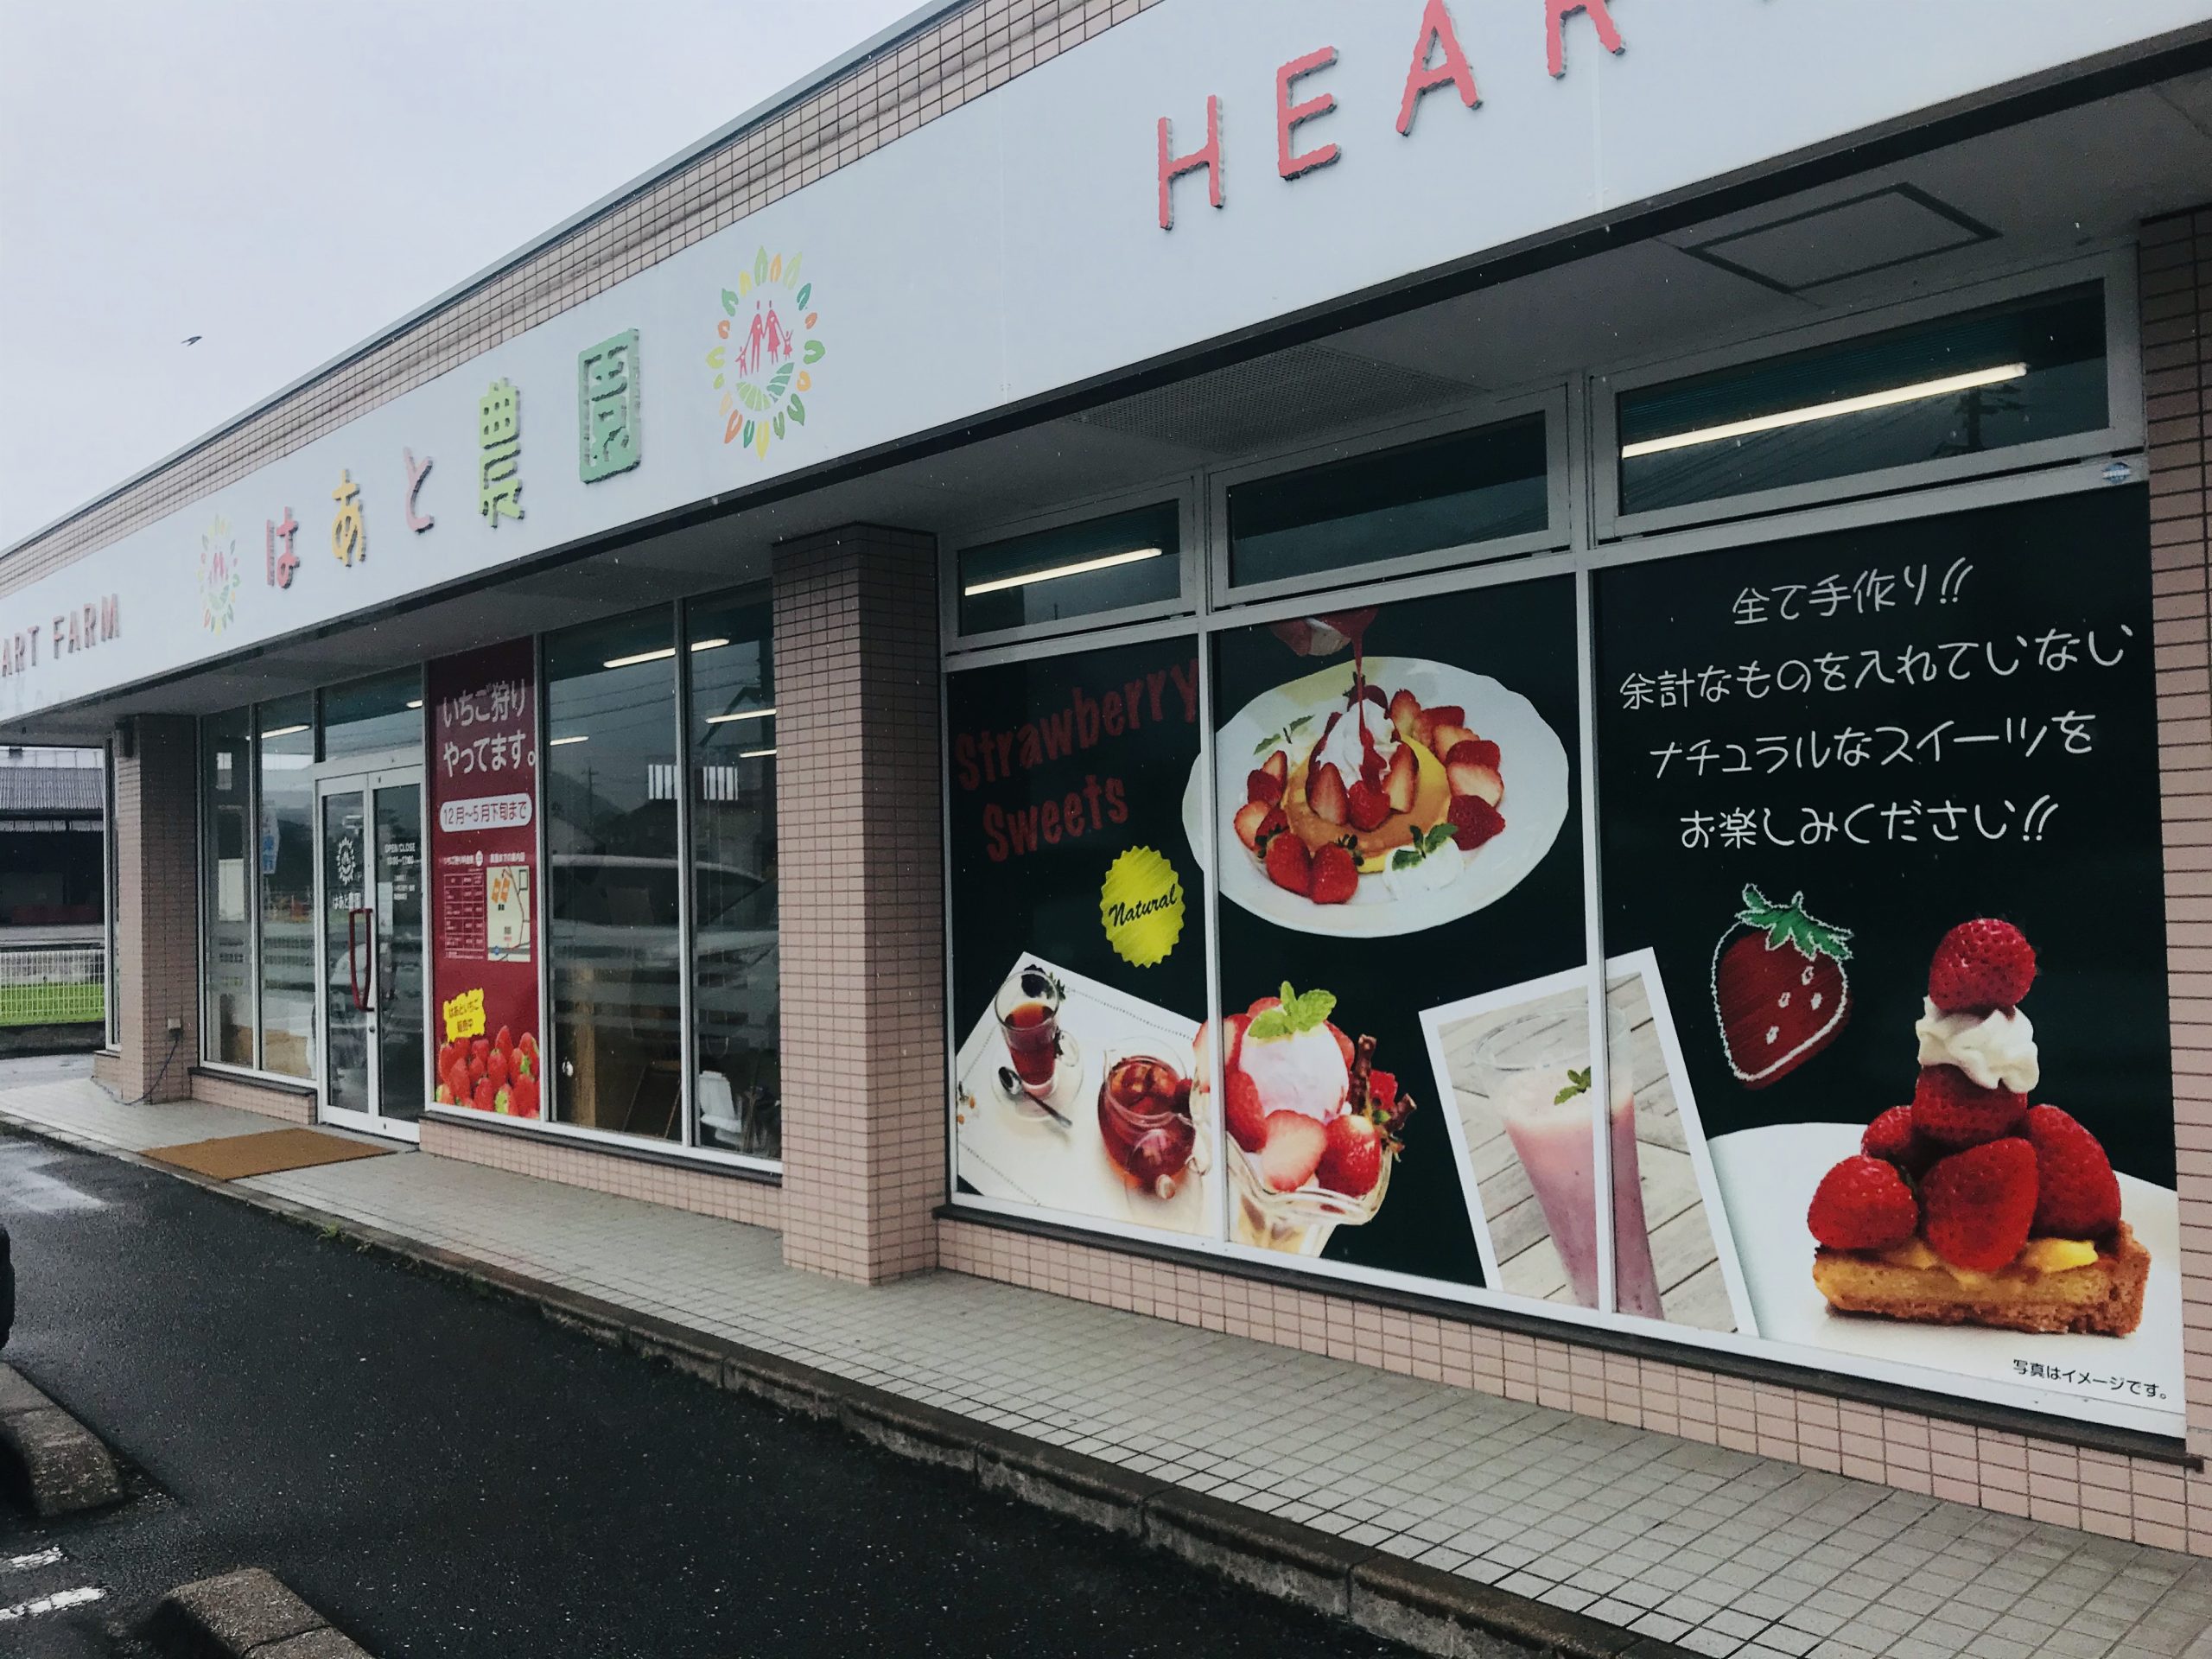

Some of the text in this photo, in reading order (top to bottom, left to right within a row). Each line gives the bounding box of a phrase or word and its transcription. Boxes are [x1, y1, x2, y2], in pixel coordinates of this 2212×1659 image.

[266, 327, 641, 589] はあと農園
[1732, 557, 1973, 625] 全て手作り!!
[2, 593, 119, 677] ART FARM
[1619, 624, 2133, 710] 余計なものを入れていない
[443, 678, 525, 728] いちご狩り
[955, 658, 1199, 790] Strawberry
[443, 729, 536, 778] やってます。
[1649, 710, 2096, 779] ナチュラルなスイーツを
[983, 775, 1128, 862] Sweets
[1680, 795, 2058, 849] お楽しみください!!
[1109, 884, 1178, 927] Natural
[2013, 1359, 2167, 1400] 写真はイメージです。
